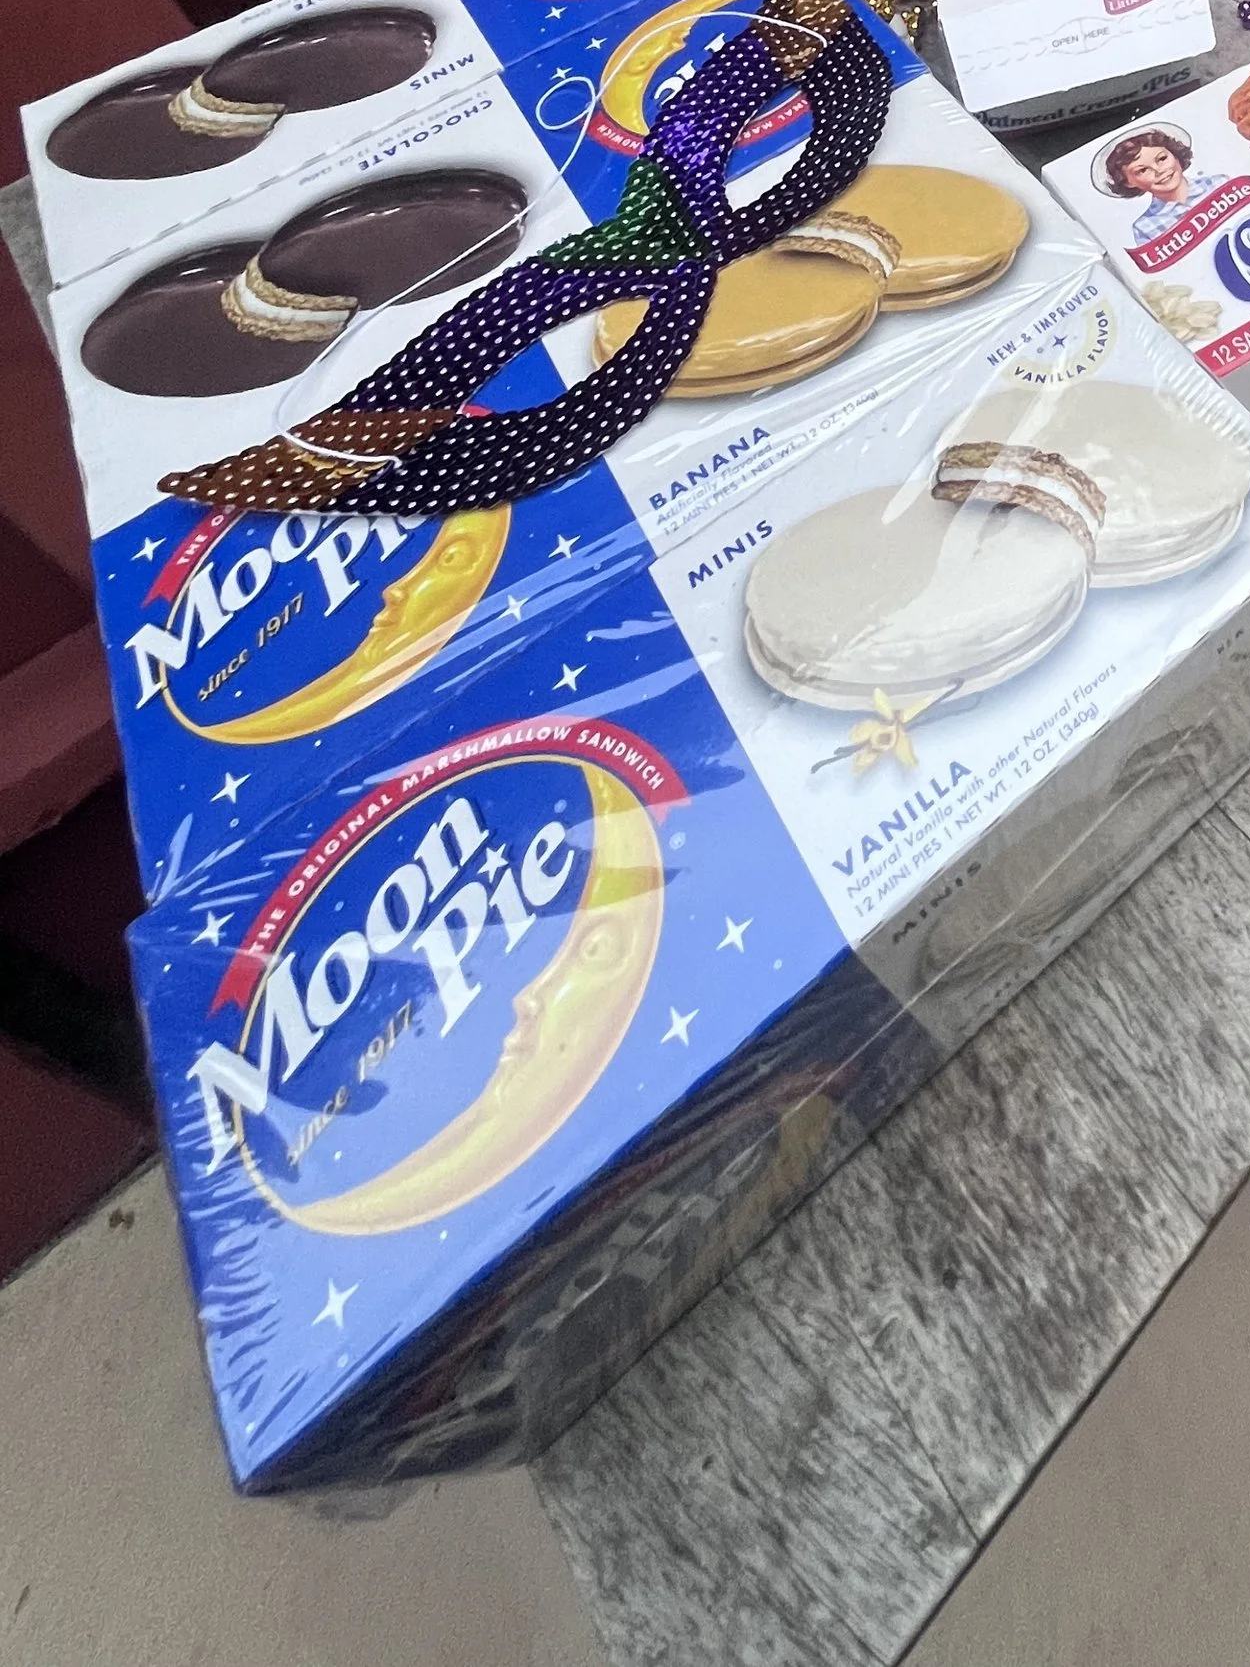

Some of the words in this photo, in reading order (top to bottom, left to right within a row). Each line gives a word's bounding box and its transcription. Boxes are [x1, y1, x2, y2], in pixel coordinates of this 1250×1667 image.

[409, 53, 474, 91] MINIS
[1052, 35, 1079, 48] OPEN
[1084, 27, 1110, 40] HERE
[358, 99, 493, 171] CHOCOLATE
[597, 124, 640, 150] NDWICH
[1140, 229, 1194, 268] Little
[986, 340, 1017, 366] NEW
[1021, 333, 1032, 343] &
[1033, 285, 1099, 334] IMPROVED
[1014, 364, 1086, 384] VANILLA
[1087, 310, 1109, 362] FLAVOR
[1212, 344, 1235, 367] 12
[649, 427, 771, 511] BANANA
[656, 480, 717, 525] Artificially
[721, 443, 772, 482] Flavored
[664, 521, 681, 537] 12
[682, 500, 712, 525] MINI
[713, 481, 739, 507] PIES
[751, 458, 776, 479] NET
[803, 427, 818, 443] 12
[176, 530, 209, 566] THE
[306, 515, 427, 617] Pi
[687, 519, 773, 589] MINIS
[124, 514, 334, 709] Moo
[199, 648, 249, 701] since
[257, 594, 304, 648] 1917
[832, 760, 972, 877] VANILLA
[847, 848, 902, 899] Natural
[904, 805, 953, 848] Vanilla
[956, 777, 985, 807] with
[988, 745, 1021, 779] other
[1023, 699, 1071, 747] Natural
[1073, 663, 1117, 704] Flavors
[854, 900, 873, 918] 12
[877, 865, 911, 903] MINI
[912, 839, 942, 870] PIES
[955, 801, 984, 832] NET
[1014, 760, 1032, 779] 12
[1034, 738, 1059, 763] OZ.
[1058, 703, 1099, 741] (340g)
[249, 908, 285, 958] THE
[289, 794, 393, 894] ORIGINAL
[400, 725, 572, 793] MARSHMALLOW
[576, 728, 664, 791] SANDWICH
[412, 820, 573, 1038] Pie
[186, 797, 489, 1175] Moon
[288, 1086, 349, 1167] since
[357, 1000, 413, 1080] 1917
